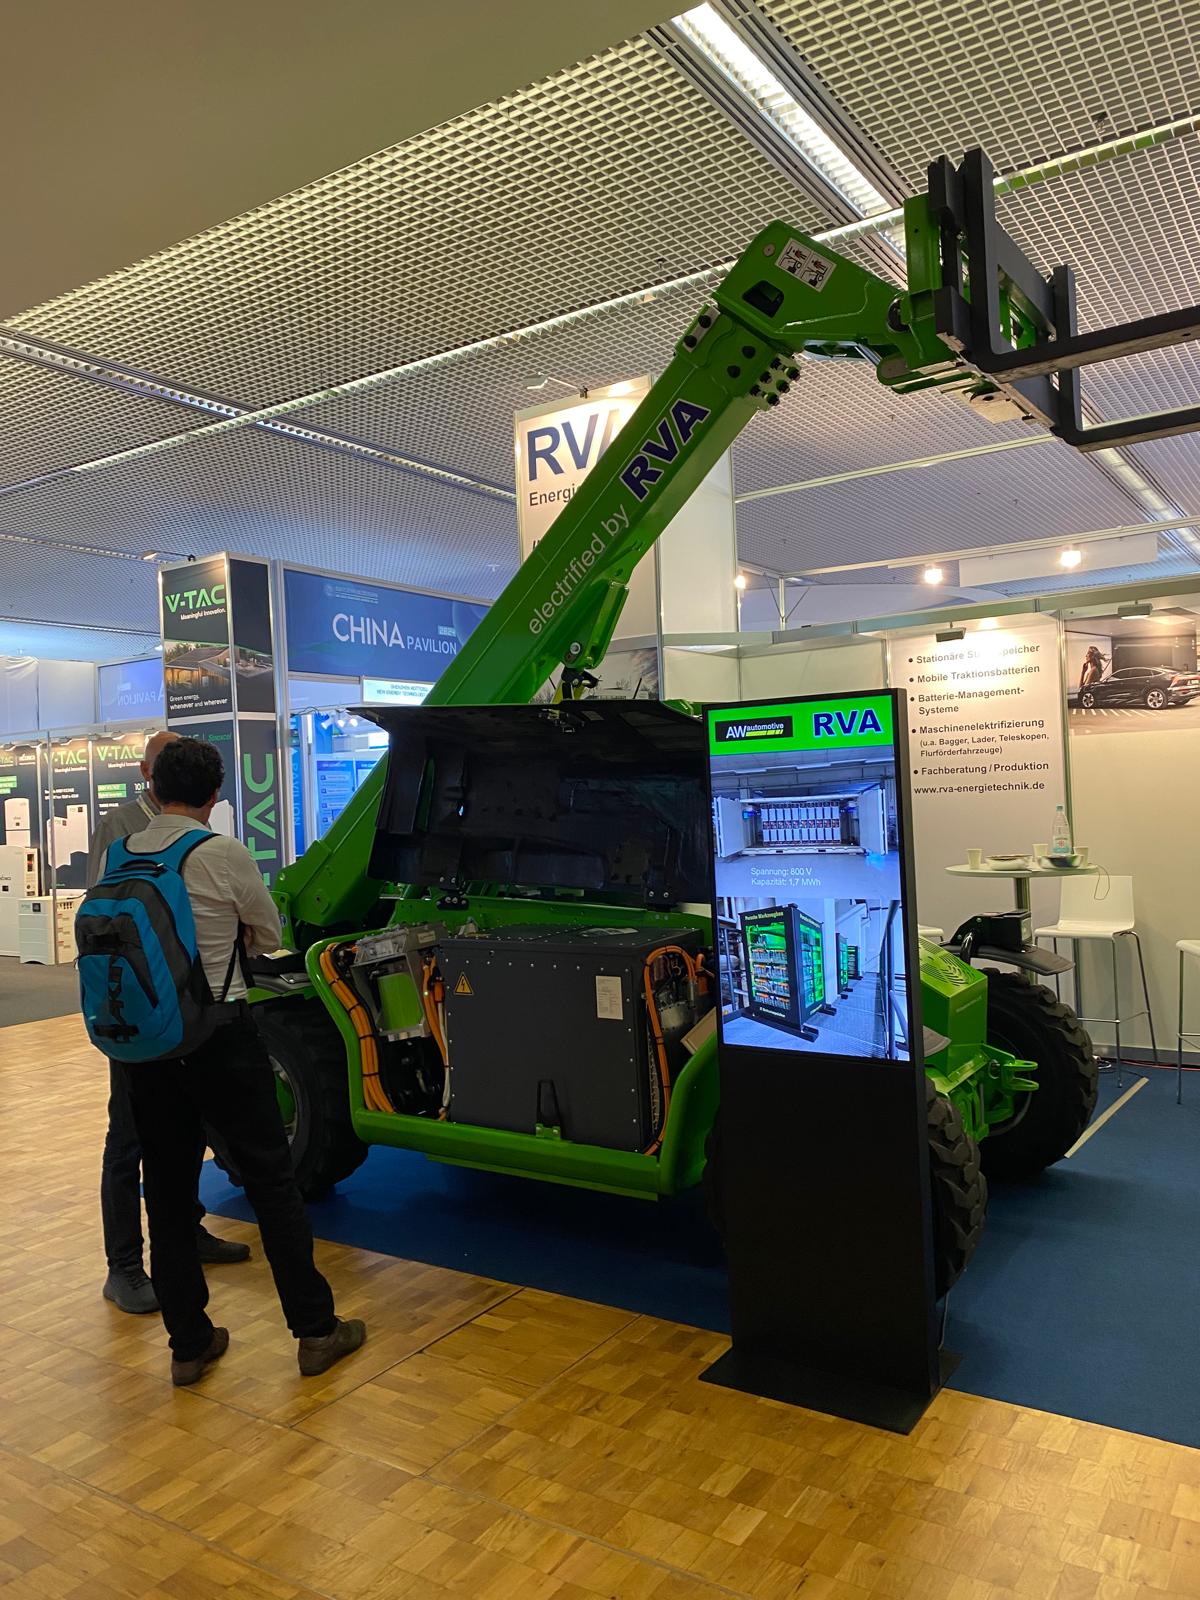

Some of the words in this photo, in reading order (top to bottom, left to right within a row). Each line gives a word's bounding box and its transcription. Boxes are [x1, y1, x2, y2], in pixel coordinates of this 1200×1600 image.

[620, 399, 711, 501] RVA
[529, 484, 581, 506] Energi
[529, 533, 605, 633] electrified
[601, 504, 629, 536] by
[165, 584, 225, 612] V-TAC
[332, 613, 405, 648] CHINA
[407, 636, 457, 655] PAVILION
[916, 653, 965, 664] Stationäre
[917, 674, 948, 683] Mobile
[951, 665, 1040, 680] Traktionsbatterien
[918, 687, 1024, 702] Batterie-Management-
[919, 705, 959, 716] Systeme
[813, 709, 883, 738] RVA
[920, 720, 1044, 734] Maschinenelektrifizierung
[939, 737, 970, 747] Bagger,
[972, 736, 997, 744] Lader,
[97, 745, 144, 760] V-TAC
[920, 746, 1003, 757] Flurförderfahrzeuge)
[921, 764, 987, 775] Fachberatung
[994, 762, 1049, 772] Produktion
[914, 782, 1045, 794] www.rva-energietechnik.de
[805, 867, 812, 875] V
